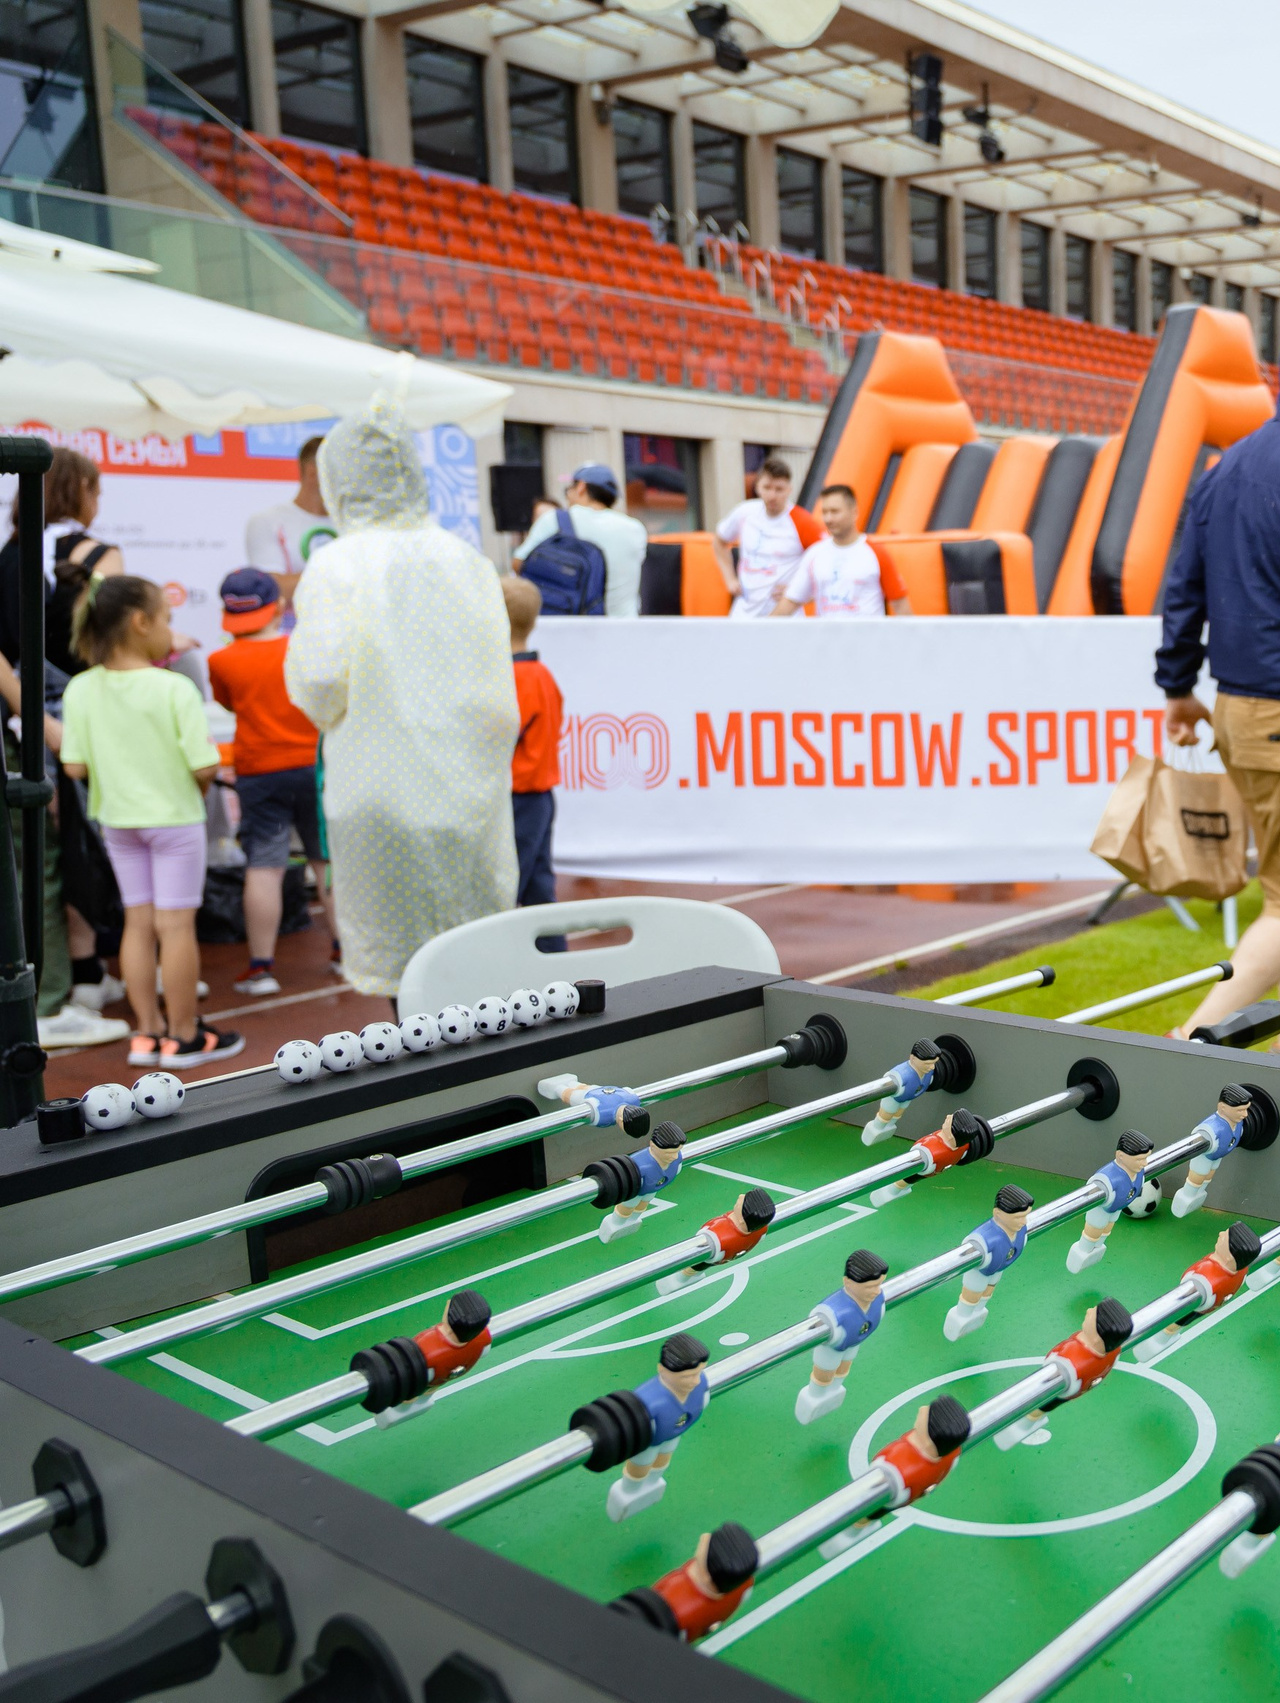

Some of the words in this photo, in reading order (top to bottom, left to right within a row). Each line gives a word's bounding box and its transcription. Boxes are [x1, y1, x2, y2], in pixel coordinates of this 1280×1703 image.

[528, 994, 540, 1007] 9
[563, 1005, 576, 1017] 10
[496, 1019, 507, 1032] 8
